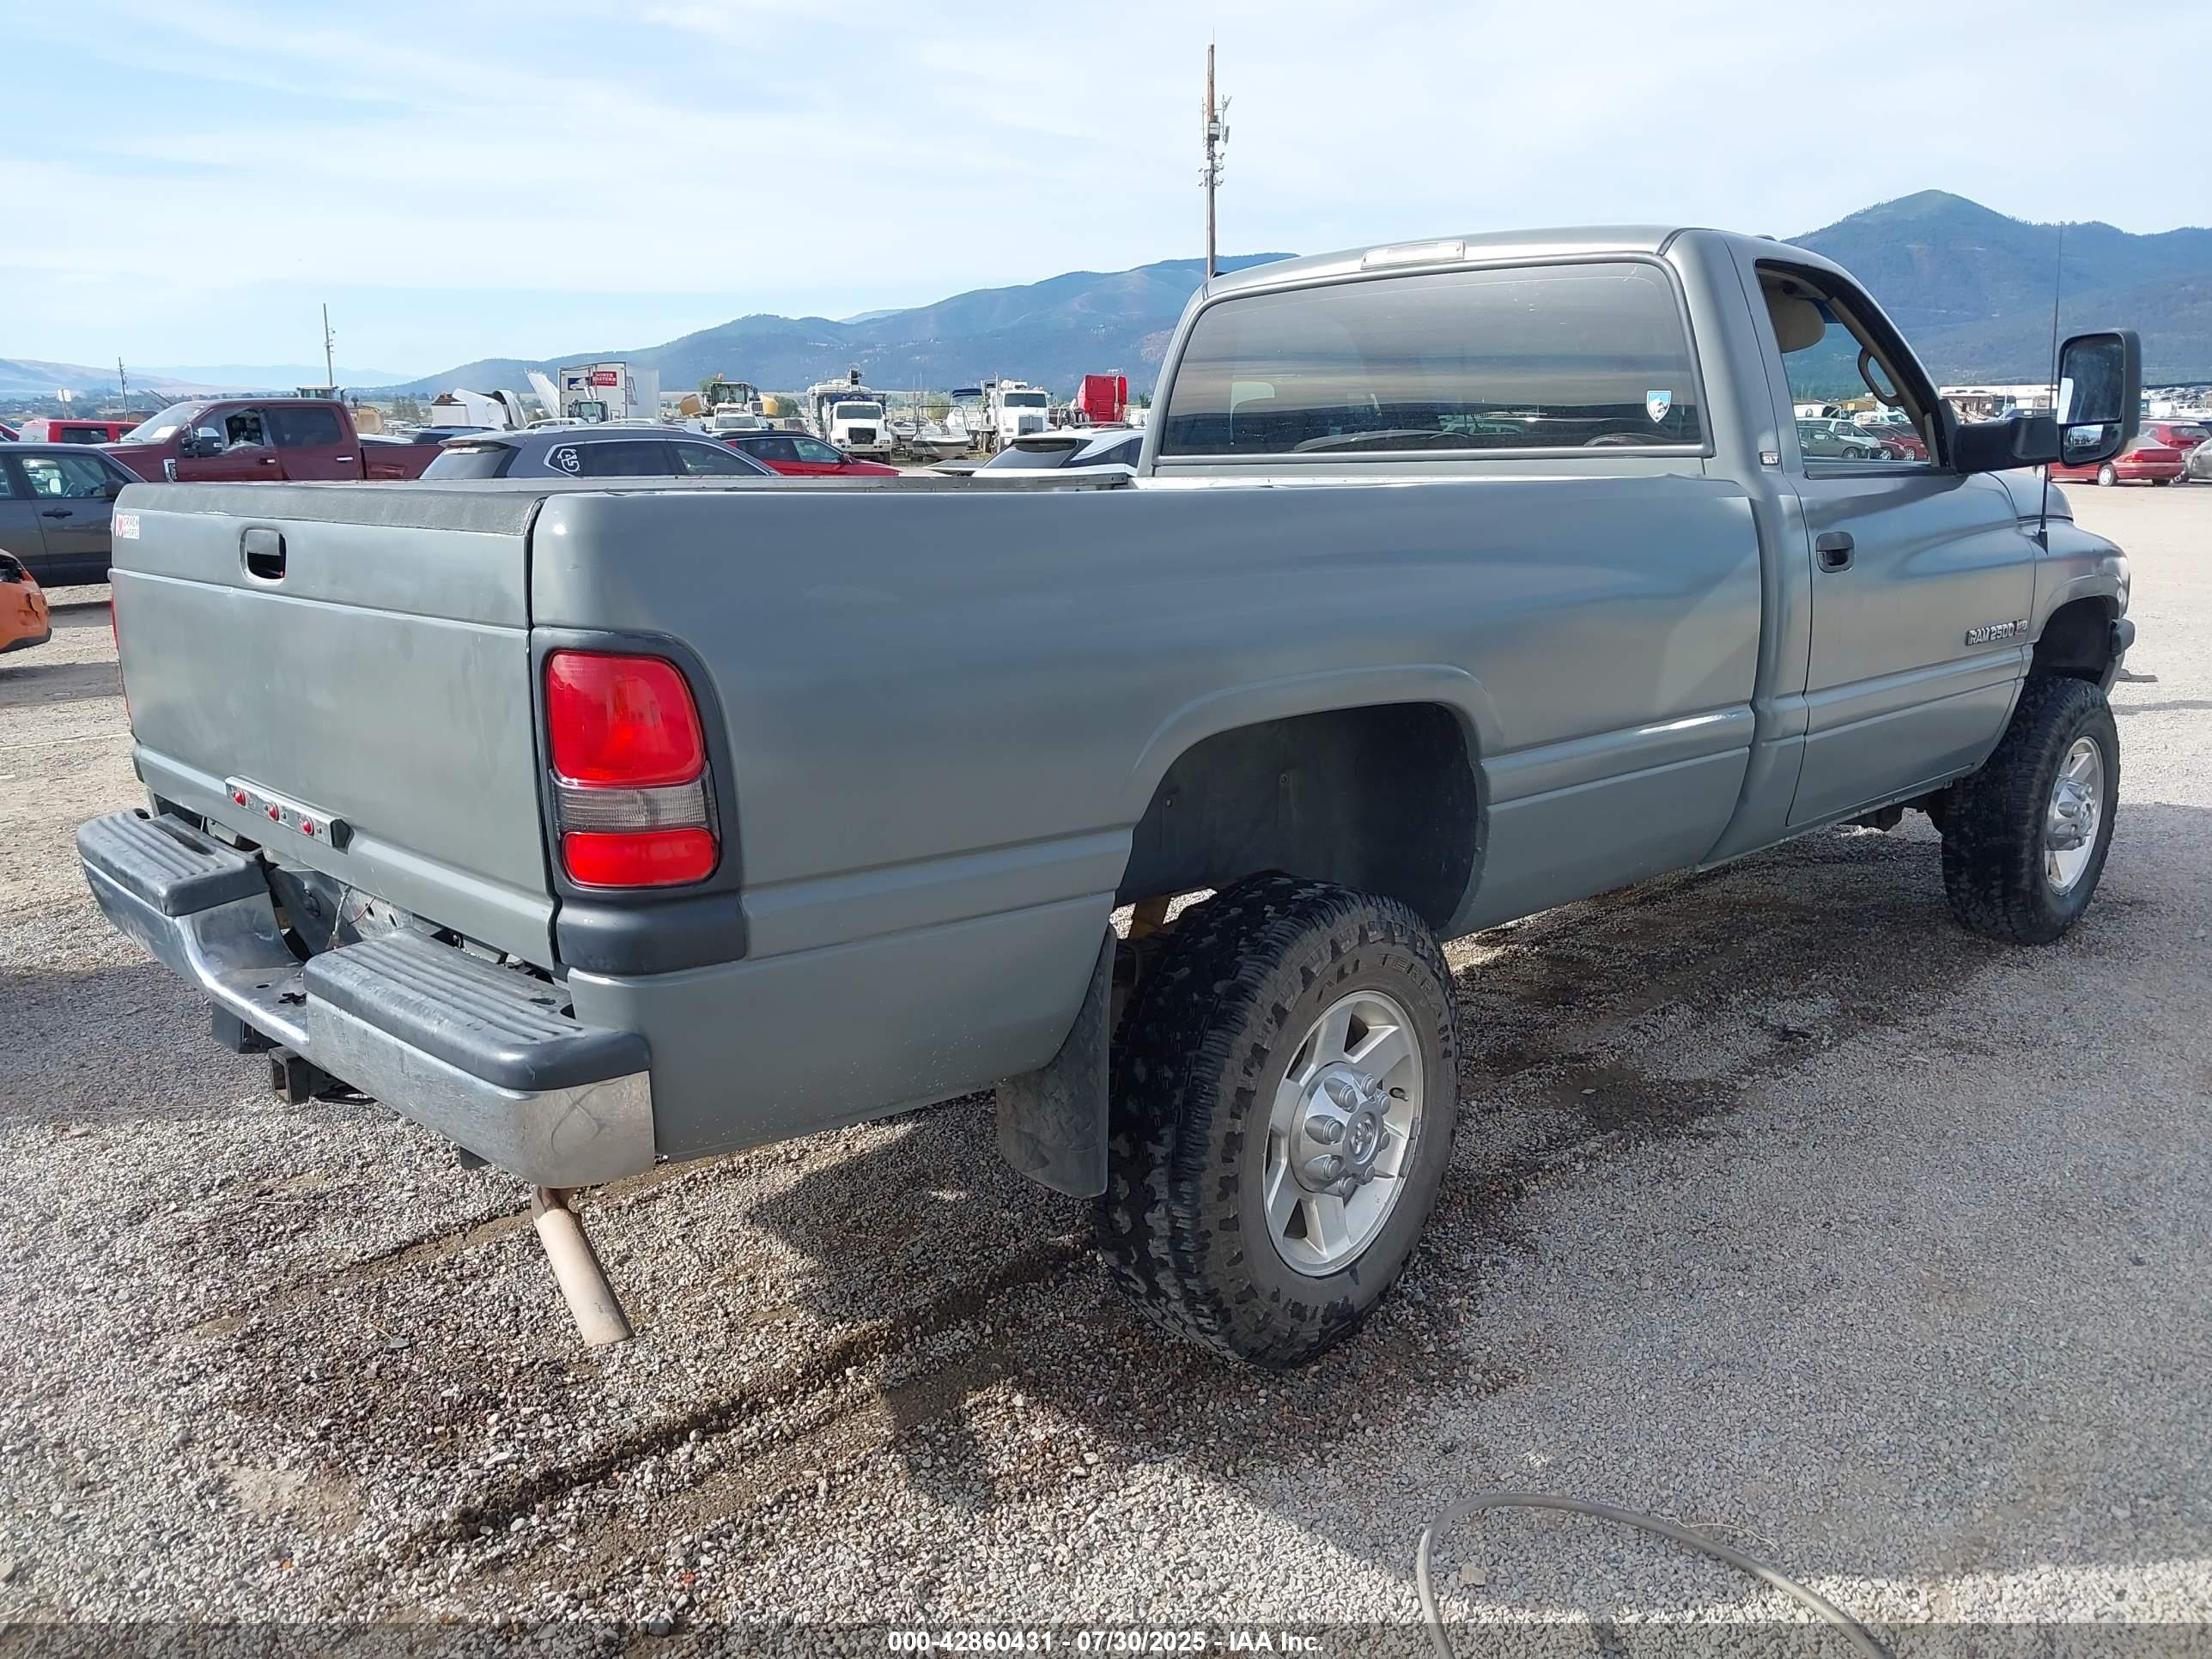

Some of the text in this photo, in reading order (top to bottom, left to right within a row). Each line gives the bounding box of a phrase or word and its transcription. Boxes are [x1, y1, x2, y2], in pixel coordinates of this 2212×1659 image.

[1762, 456, 1779, 465] SLT
[1970, 628, 1990, 645] RAM
[1990, 623, 2014, 641] 2500
[1317, 957, 1368, 1003] ALL
